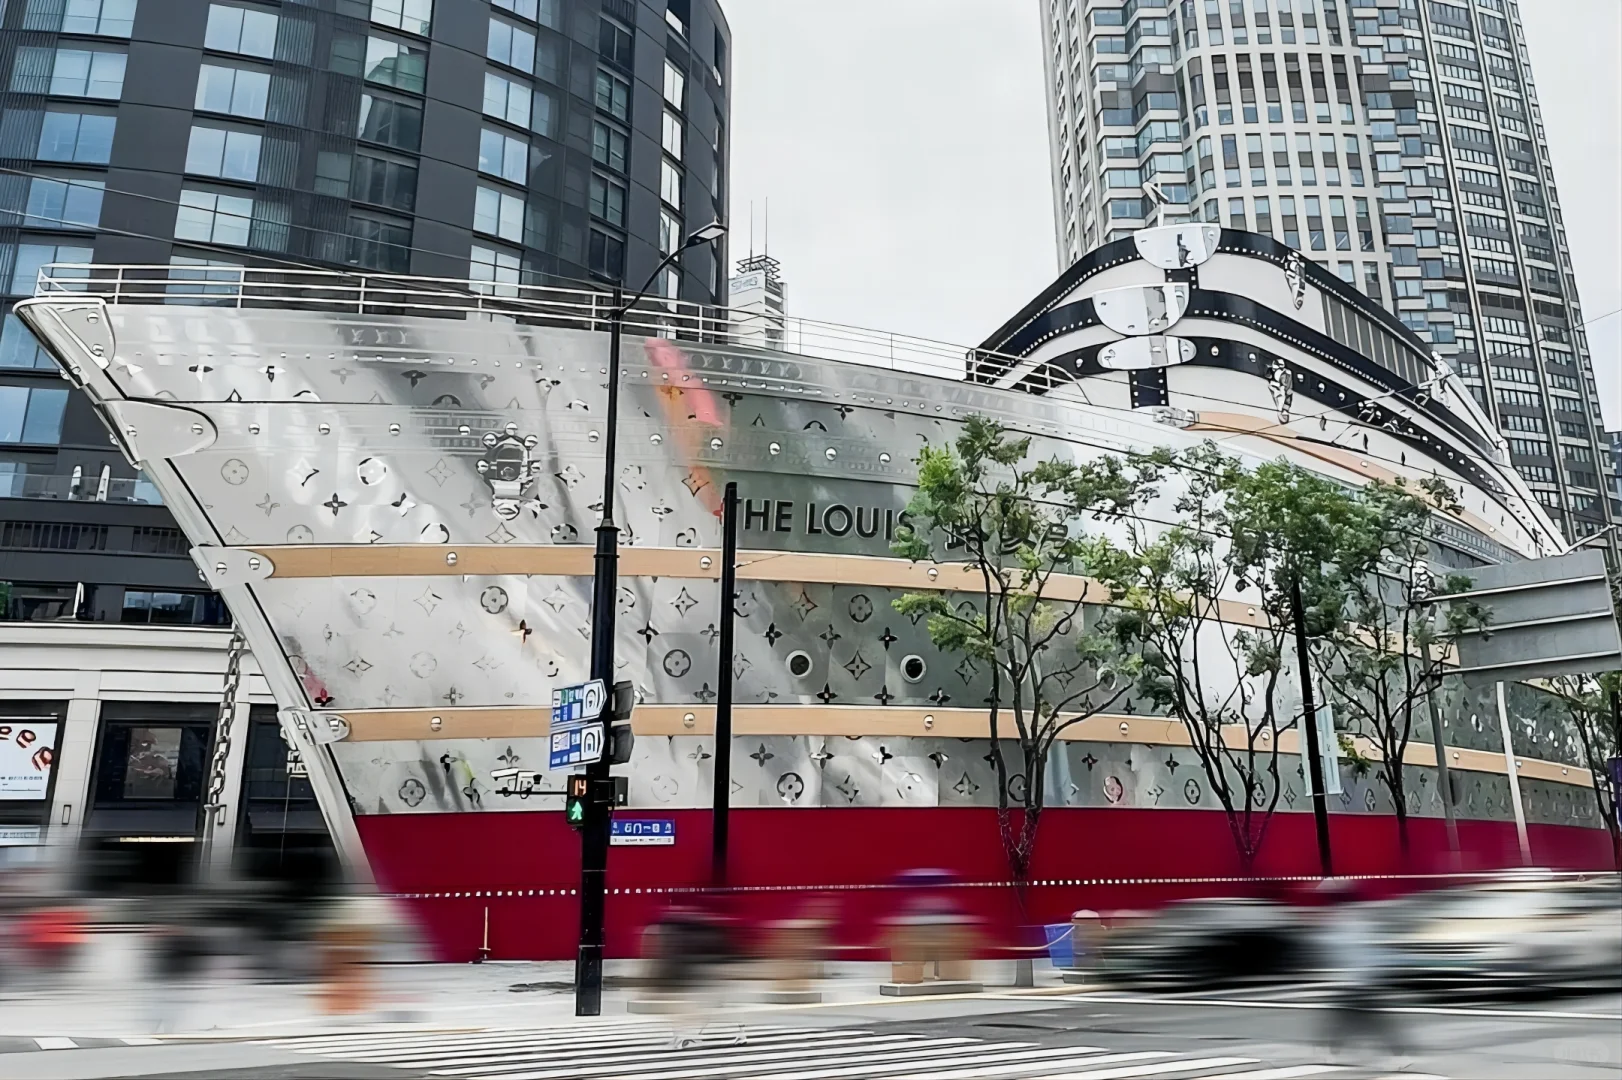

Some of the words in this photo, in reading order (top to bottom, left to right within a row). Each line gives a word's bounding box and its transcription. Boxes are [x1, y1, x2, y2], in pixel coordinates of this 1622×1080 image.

[737, 497, 794, 532] HE
[805, 502, 915, 543] LOUIS
[574, 779, 587, 796] 14
